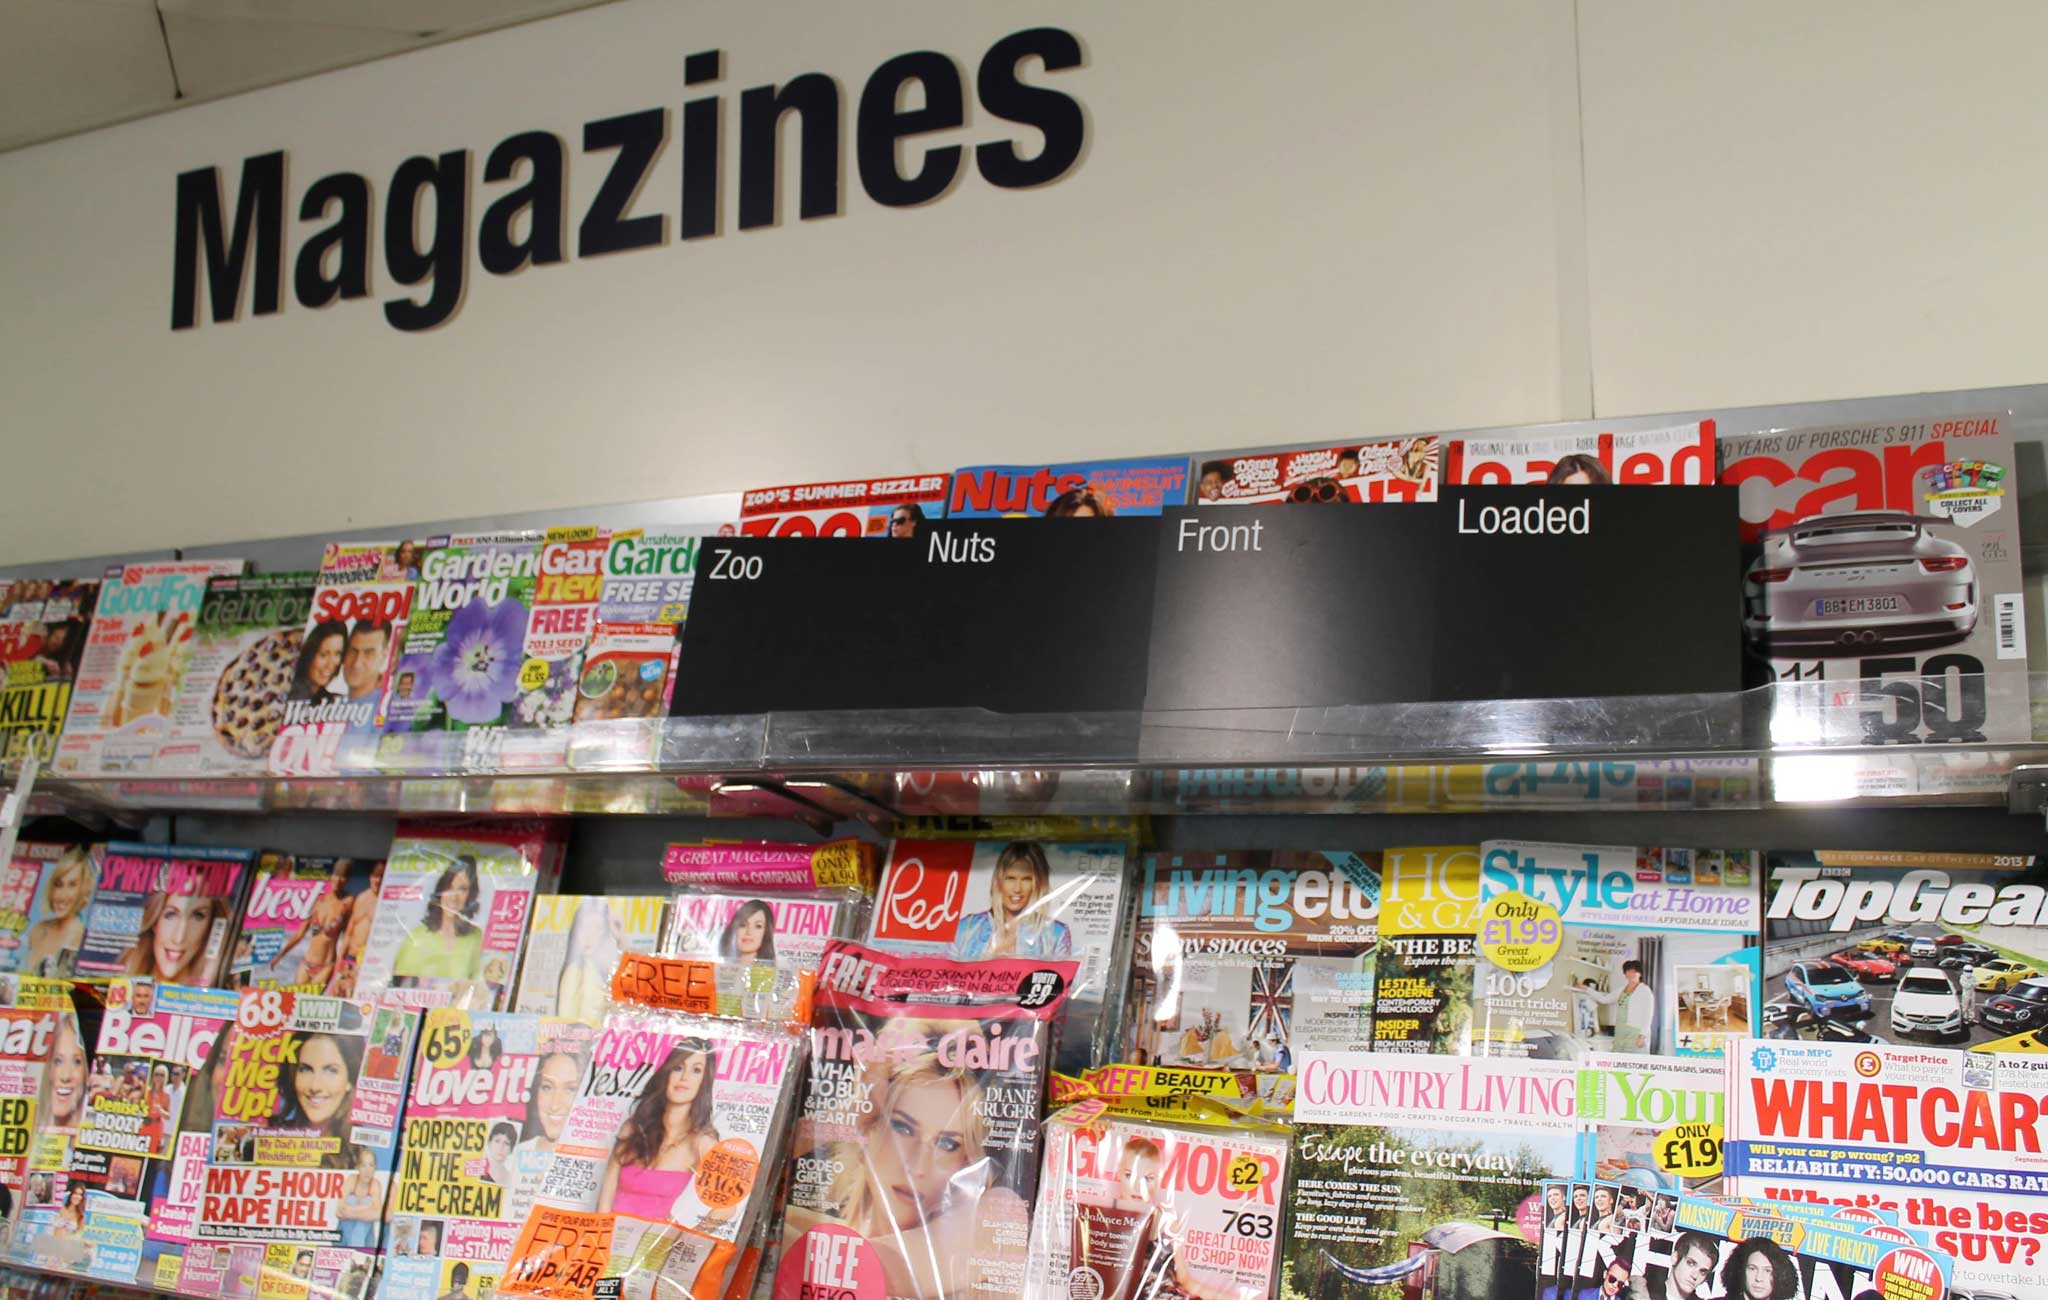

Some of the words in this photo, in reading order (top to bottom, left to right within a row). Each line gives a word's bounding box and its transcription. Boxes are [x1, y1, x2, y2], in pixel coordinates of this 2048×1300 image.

[171, 27, 1088, 331] Magazines
[1737, 437, 1780, 456] YEARS
[1786, 434, 1806, 451] OF
[1809, 427, 1893, 449] PORSCHE'S
[1899, 424, 1924, 441] 911
[1930, 419, 2000, 440] SPECIAL
[746, 490, 790, 506] ZOO'S
[794, 482, 867, 501] SUMMER
[870, 476, 943, 496] SIZZLER
[1721, 441, 1945, 541] car
[1457, 499, 1590, 535] Loaded
[928, 531, 995, 563] Nuts
[1177, 518, 1264, 551] Front
[709, 549, 763, 580] Zoo
[417, 578, 509, 610] World
[602, 581, 662, 603] FREE
[1866, 597, 1898, 610] 3801
[531, 608, 590, 635] FREE
[1859, 653, 1987, 738] 50
[284, 699, 374, 728] Wedding
[680, 851, 728, 865] GREAT
[729, 849, 811, 864] MAGAZINES
[816, 855, 851, 870] ONLY
[1994, 855, 2024, 867] 2013
[99, 854, 156, 892] SPIRIT
[165, 861, 243, 897] DESTINY
[749, 870, 809, 884] COMPANY
[1481, 848, 1634, 917] Style
[1630, 890, 1662, 911] at
[1663, 888, 1750, 915] Home
[248, 872, 325, 921] best
[882, 858, 960, 932] Red
[1496, 902, 1539, 921] Only
[1483, 919, 1558, 945] £1.99
[1207, 936, 1288, 959] spaces
[1393, 938, 1438, 955] THE
[1498, 946, 1528, 955] Great
[1508, 955, 1541, 966] value!
[820, 952, 887, 1002] FREE
[936, 969, 987, 982] SKINNY
[989, 970, 1022, 982] MINI
[981, 982, 1017, 993] BLACK
[1393, 979, 1427, 989] STYLE
[1485, 975, 1535, 997] 100
[1378, 988, 1434, 998] MODERNE
[1527, 997, 1568, 1010] tricks
[1375, 1030, 1408, 1040] STYLE
[1376, 1020, 1419, 1030] INSIDER
[231, 1034, 303, 1065] Pick
[938, 1023, 1039, 1073] claire
[1780, 1048, 1804, 1057] True
[1807, 1049, 1832, 1057] MPG
[1884, 1052, 1918, 1064] Target
[1920, 1054, 1948, 1065] Price
[226, 1060, 279, 1090] Me
[416, 1057, 493, 1106] love
[492, 1054, 540, 1105] it!
[811, 1062, 862, 1081] WHAT
[1155, 1073, 1231, 1090] BEAUTY
[809, 1079, 834, 1095] TO
[835, 1081, 873, 1098] BUY
[986, 1088, 1037, 1104] DIANE
[1304, 1059, 1453, 1110] COUNTRY
[1460, 1064, 1575, 1117] LIVING
[94, 1094, 150, 1117] Denise's
[222, 1088, 278, 1122] Up!
[973, 1102, 1036, 1120] KRUGER
[1751, 1078, 1917, 1144] WHAT
[95, 1112, 144, 1132] BOOZY
[804, 1111, 841, 1125] WEAR
[80, 1129, 151, 1153] WEDDING!
[408, 1119, 487, 1151] CORPSES
[1676, 1124, 1710, 1138] ONLY
[797, 1158, 844, 1173] RODEO
[1299, 1134, 1363, 1172] Escape
[1369, 1142, 1405, 1165] the
[1411, 1149, 1520, 1176] everyday
[1664, 1138, 1723, 1169] £1.9
[1749, 1144, 1776, 1155] Will
[1778, 1146, 1808, 1158] your
[1809, 1148, 1828, 1158] car
[1830, 1150, 1846, 1161] go
[1847, 1150, 1894, 1163] wrong?
[1896, 1153, 1920, 1165] p92
[405, 1150, 423, 1181] IN
[429, 1151, 460, 1183] THE
[796, 1170, 834, 1185] GIRLS
[1232, 1164, 1259, 1184] £2
[1380, 1168, 1413, 1179] gardens,
[1749, 1158, 1881, 1181] RELIABILITY:
[1882, 1163, 1950, 1186] 50,000
[1952, 1170, 2007, 1189] CARS
[206, 1169, 251, 1195] MY
[255, 1171, 345, 1199] 5-HOUR
[1298, 1179, 1322, 1189] HERE
[1325, 1181, 1358, 1191] COMES
[1360, 1183, 1379, 1192] THE
[1381, 1184, 1401, 1194] SUN
[203, 1197, 271, 1225] RAPE
[276, 1199, 328, 1227] HELL
[400, 1181, 501, 1218] ICE-CREAM
[1222, 1209, 1274, 1239] 763
[1296, 1213, 1315, 1223] THE
[1317, 1214, 1342, 1225] GOOD
[1345, 1216, 1367, 1225] LIFE
[1680, 1201, 1730, 1235] MASSIVE
[1743, 1217, 1794, 1233] WARPED
[1906, 1198, 1971, 1229] the
[449, 1217, 491, 1242] Fighting
[1775, 1231, 1793, 1243] '13
[1187, 1230, 1227, 1249] GREAT
[1230, 1234, 1270, 1255] LOOKS
[1807, 1231, 1833, 1253] LIVE
[1835, 1235, 1879, 1265] FRENZY!
[1936, 1231, 2041, 1266] SUV?
[803, 1231, 864, 1290] FREE
[1184, 1245, 1200, 1260] TO
[1202, 1247, 1236, 1266] SHOP
[1238, 1252, 1268, 1270] NOW
[1893, 1251, 1934, 1285] WIN!
[183, 1268, 220, 1284] Horror!
[1978, 1272, 2033, 1286] overtake
